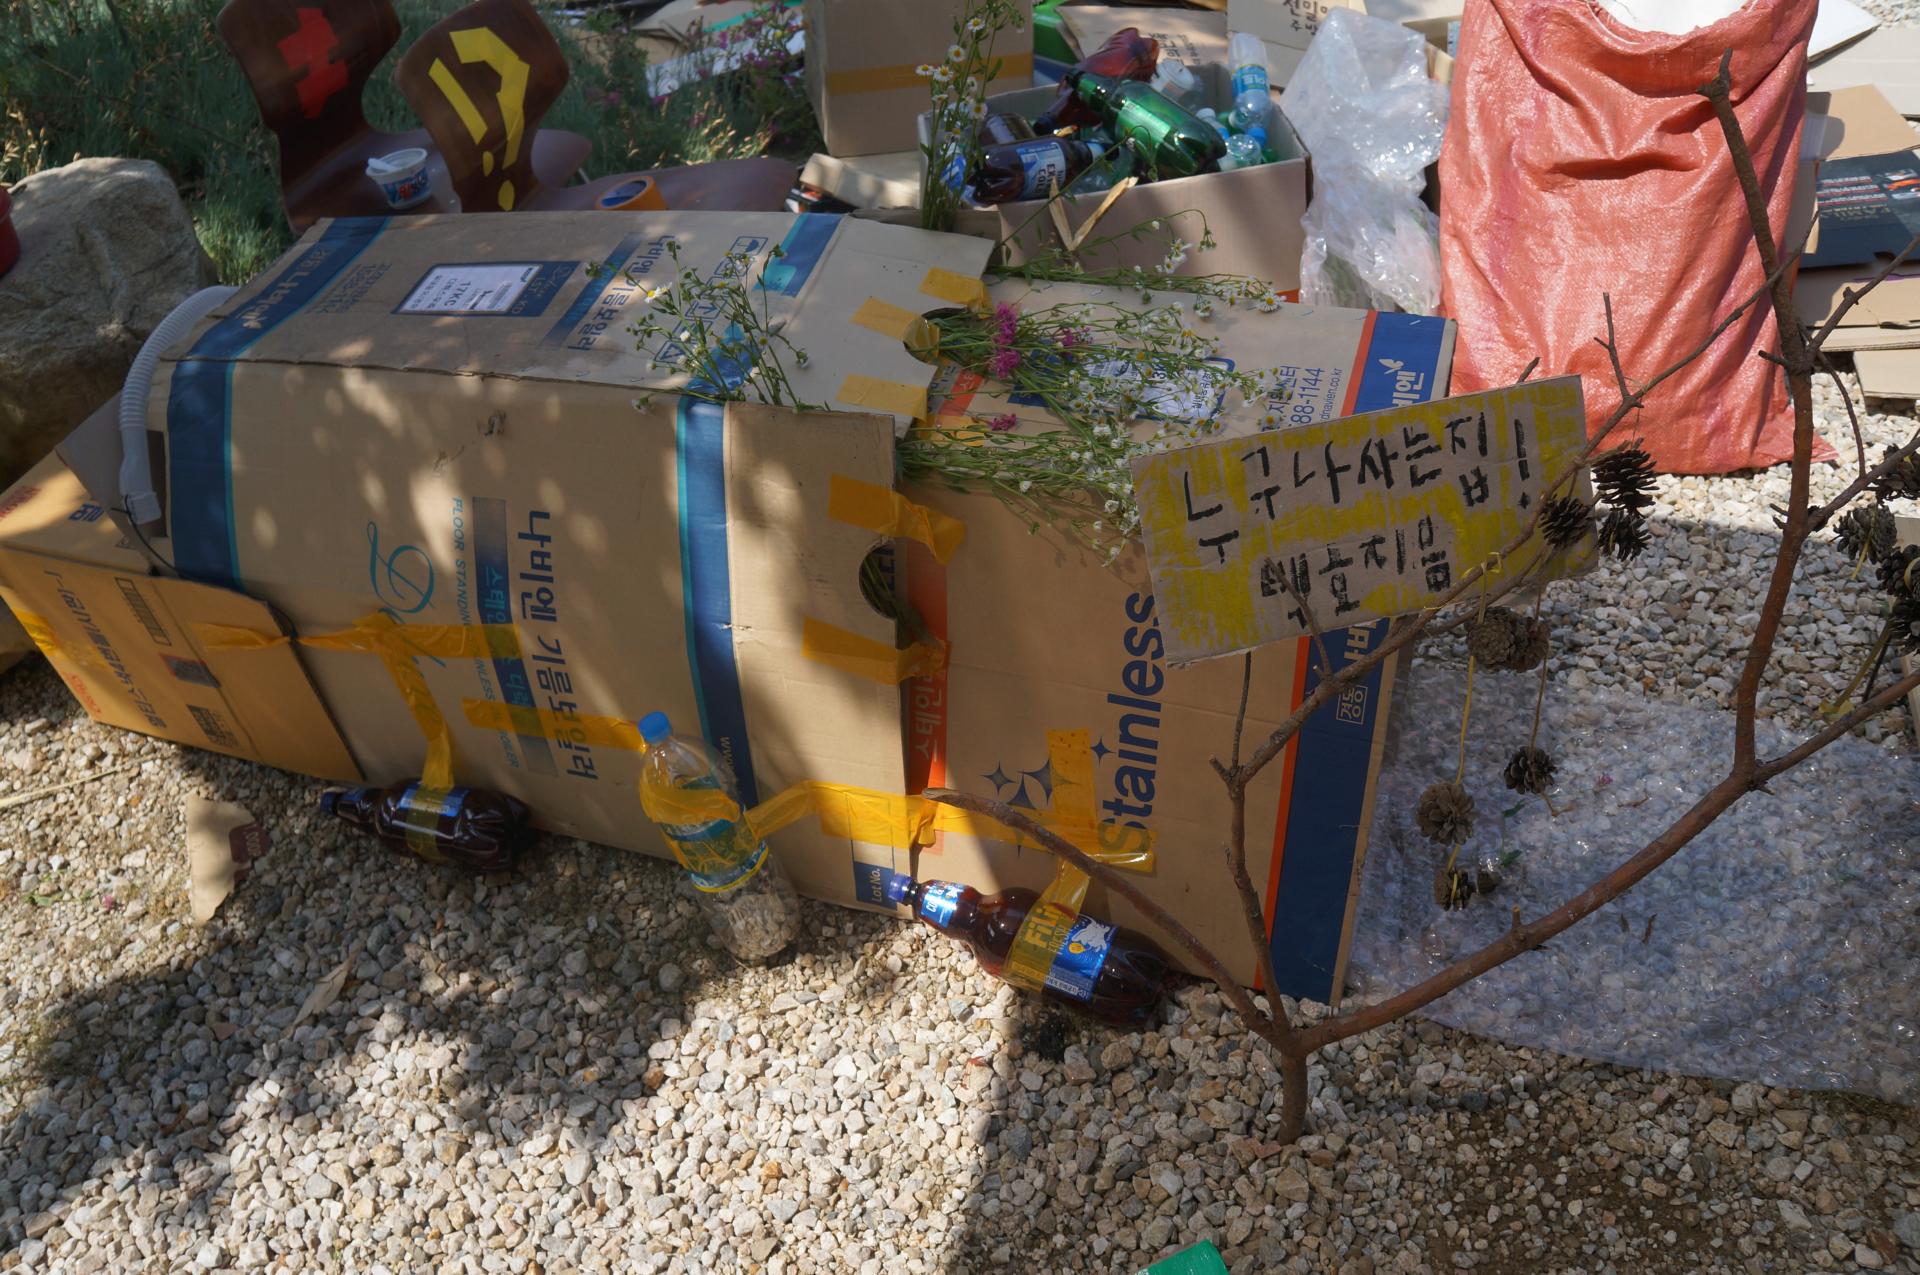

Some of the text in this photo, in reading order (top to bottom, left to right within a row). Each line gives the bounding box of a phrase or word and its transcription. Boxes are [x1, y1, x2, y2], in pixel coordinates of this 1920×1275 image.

[1288, 367, 1326, 427] 88-1144
[452, 496, 465, 551] FLOOR
[517, 510, 599, 781] 나비엔 기름보일러
[1099, 591, 1165, 857] Stainless
